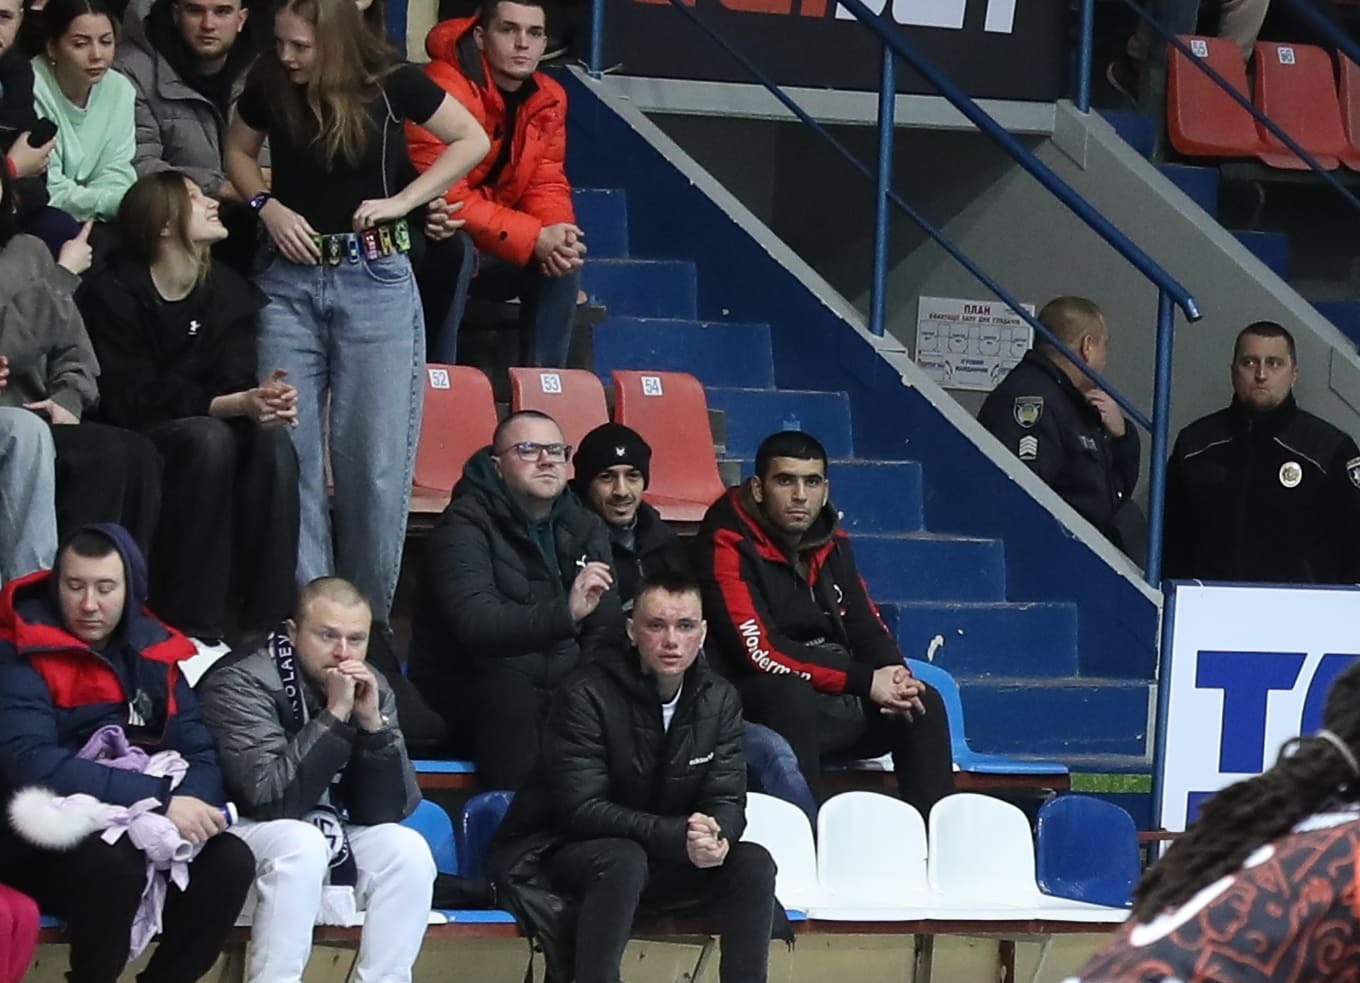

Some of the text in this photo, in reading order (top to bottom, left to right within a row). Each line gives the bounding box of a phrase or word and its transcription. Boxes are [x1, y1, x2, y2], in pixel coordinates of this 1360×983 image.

[964, 304, 991, 315] ПЛАН
[432, 371, 448, 387] 52
[543, 376, 559, 392] 53
[644, 379, 660, 394] 54
[739, 619, 812, 681] Wodermn
